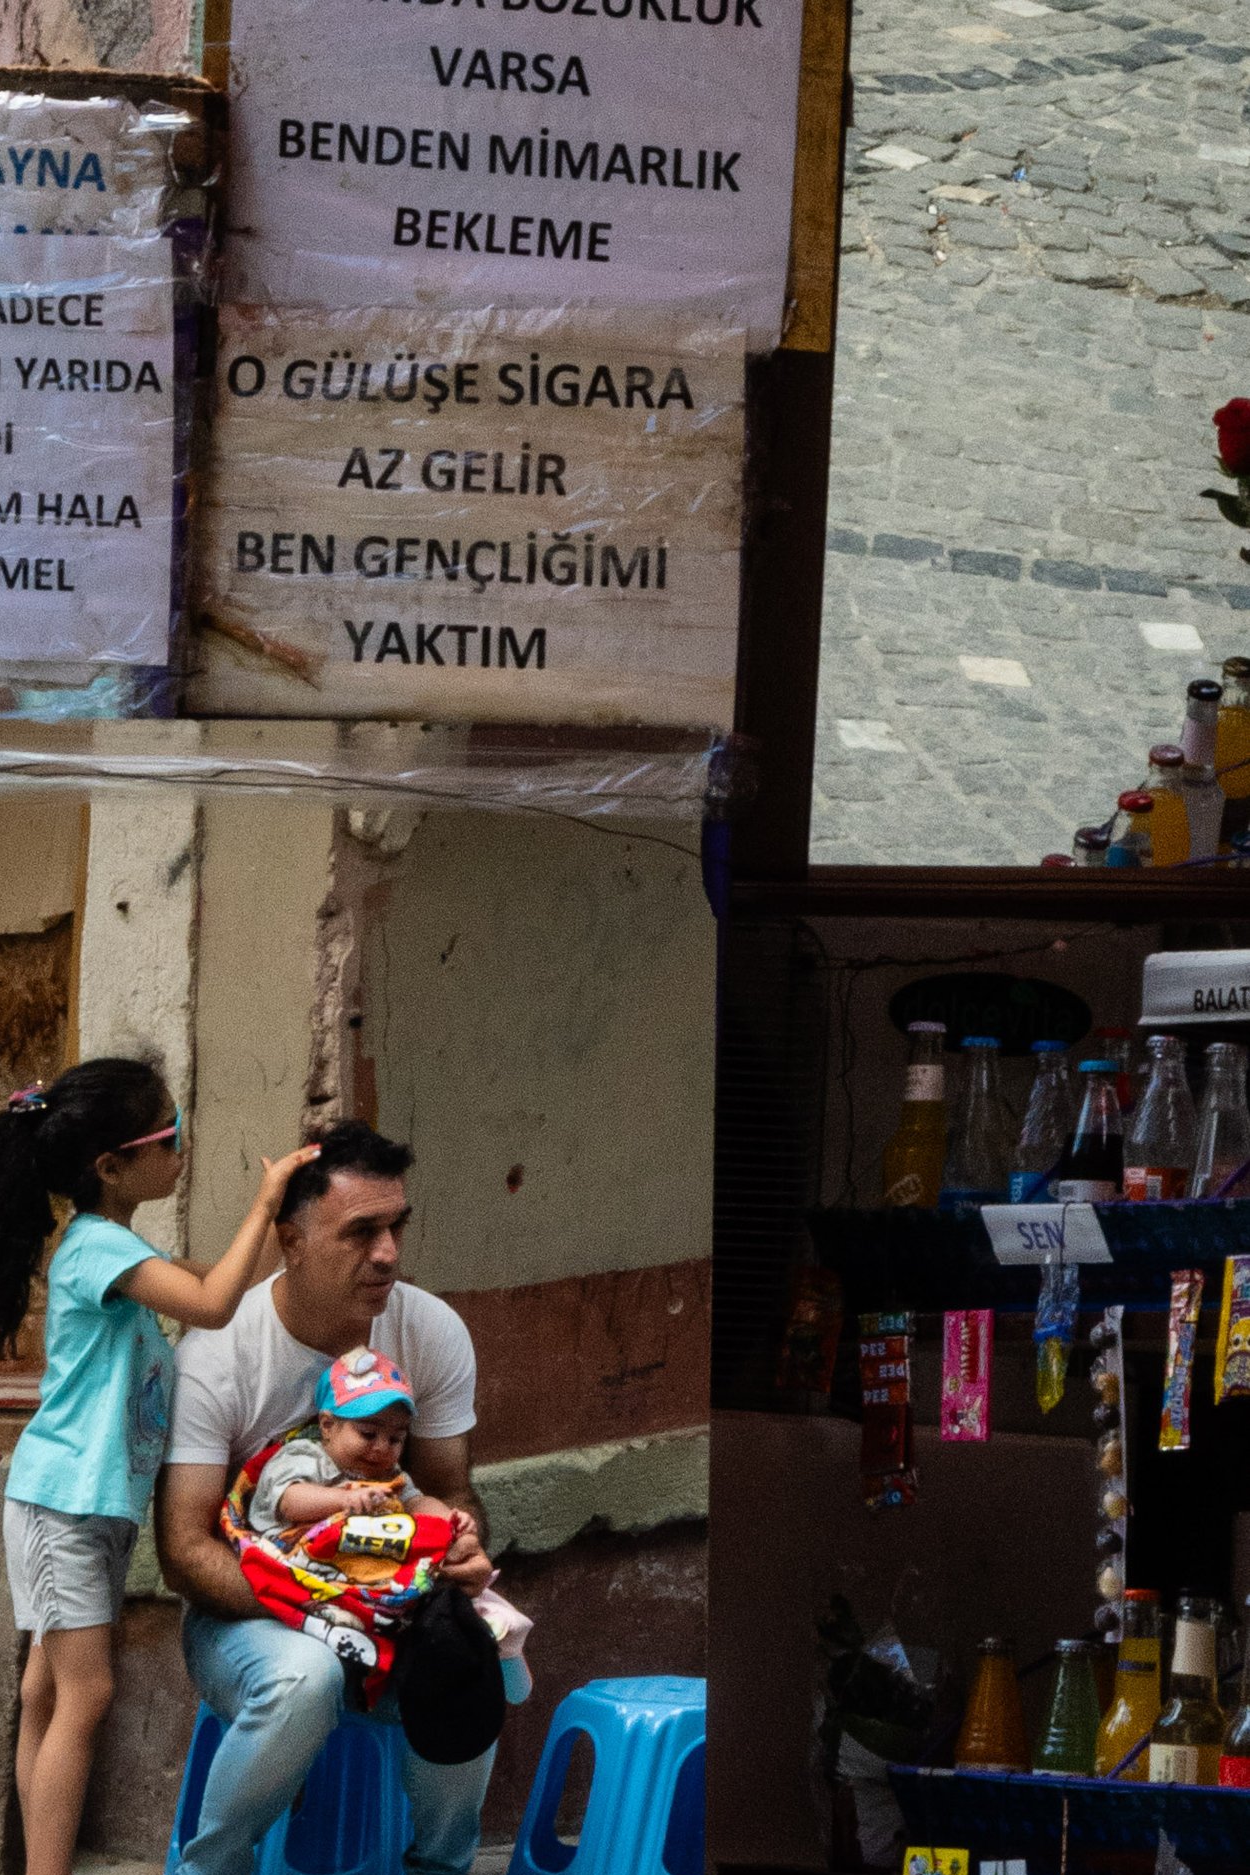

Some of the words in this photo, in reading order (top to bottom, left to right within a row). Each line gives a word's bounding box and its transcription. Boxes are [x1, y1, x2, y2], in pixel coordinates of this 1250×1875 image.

[501, 0, 763, 27] KLUK
[430, 47, 591, 97] VARSA
[278, 119, 470, 172] BENDEN
[488, 128, 743, 192] MİMARLIK
[394, 208, 612, 263] BEKLEME
[17, 357, 162, 394] YARIDA
[228, 355, 264, 397] O
[282, 351, 478, 414] GÜLÜŞE
[498, 353, 694, 410] SİGARA
[338, 448, 404, 489] AZ
[422, 442, 567, 496] GELİR
[38, 492, 142, 528] HALA
[236, 531, 335, 575] BEN
[353, 530, 668, 594] GENÇLİĞİMİ
[343, 620, 546, 670] YAKTIM
